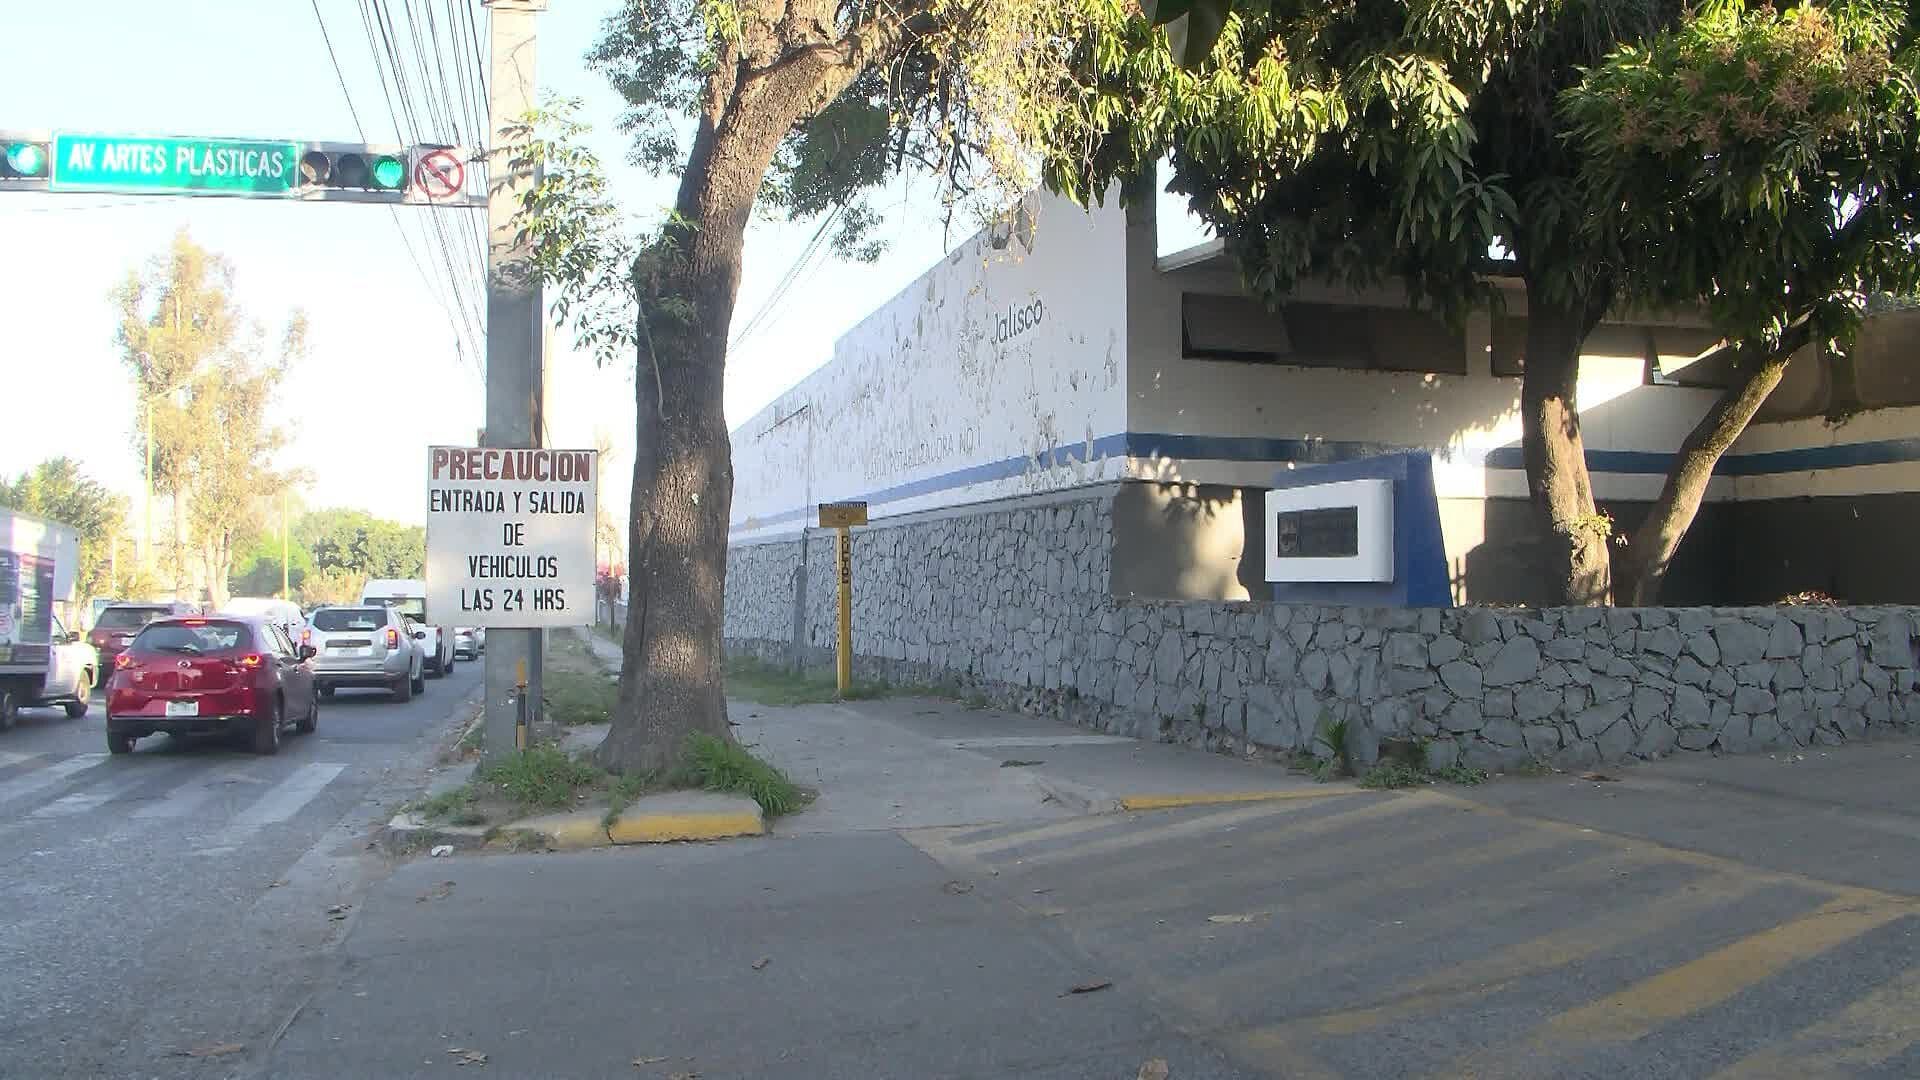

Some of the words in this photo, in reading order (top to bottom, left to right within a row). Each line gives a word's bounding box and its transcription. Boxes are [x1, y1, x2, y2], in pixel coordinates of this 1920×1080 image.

[102, 143, 168, 174] ARTES
[175, 145, 283, 178] PLÁSTICAS
[990, 299, 1043, 344] Jalisco
[432, 449, 590, 482] PRECAUCION
[430, 489, 505, 513] ENTRADA
[513, 491, 522, 514] Y
[529, 491, 585, 514] SALIDA
[503, 523, 525, 546] DE
[469, 555, 558, 578] VEHICULOS
[461, 588, 493, 612] LAS
[503, 588, 525, 611] 24
[533, 588, 570, 612] HRS.
